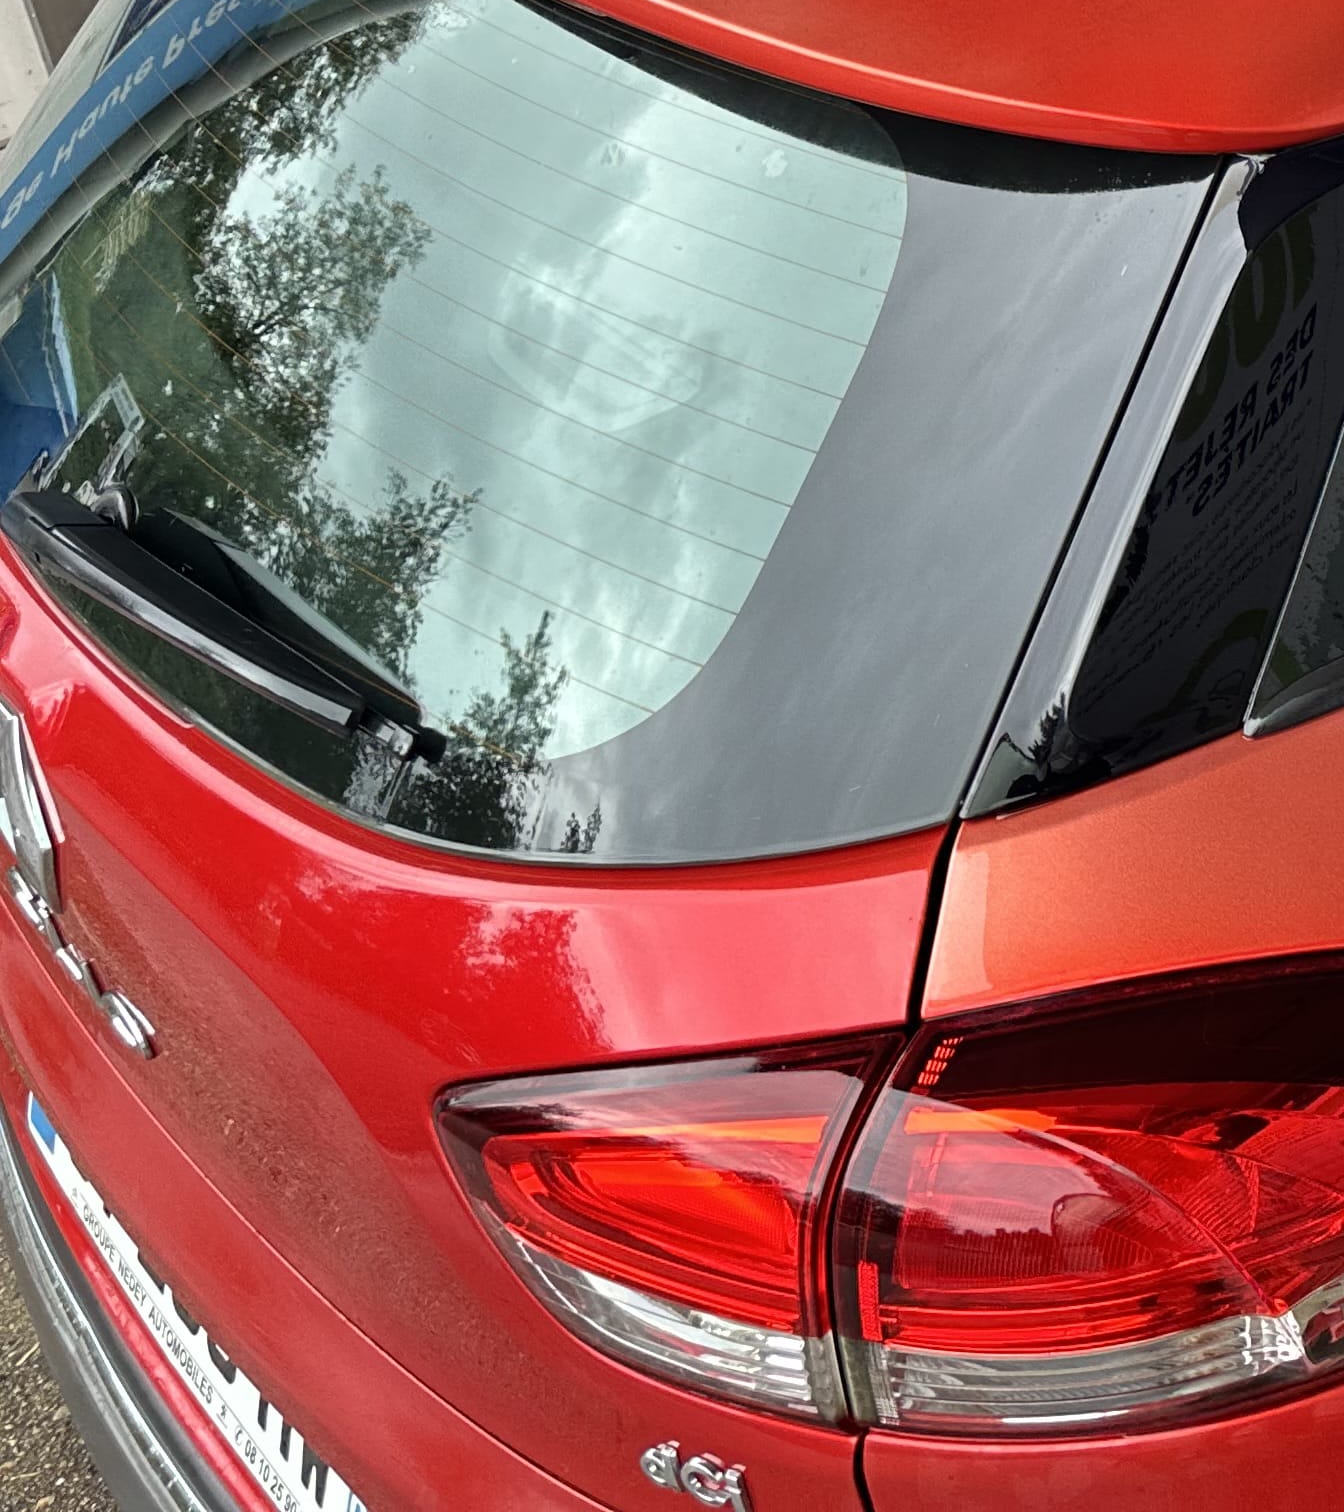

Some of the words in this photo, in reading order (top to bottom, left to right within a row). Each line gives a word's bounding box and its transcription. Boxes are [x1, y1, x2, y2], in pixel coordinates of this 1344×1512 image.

[83, 1203, 117, 1263] GROUPE
[117, 1257, 147, 1308] NEDEY
[148, 1306, 214, 1405] AUTOMOBILES
[244, 1439, 257, 1465] 08
[258, 1458, 270, 1483] 10
[270, 1475, 284, 1502] 25
